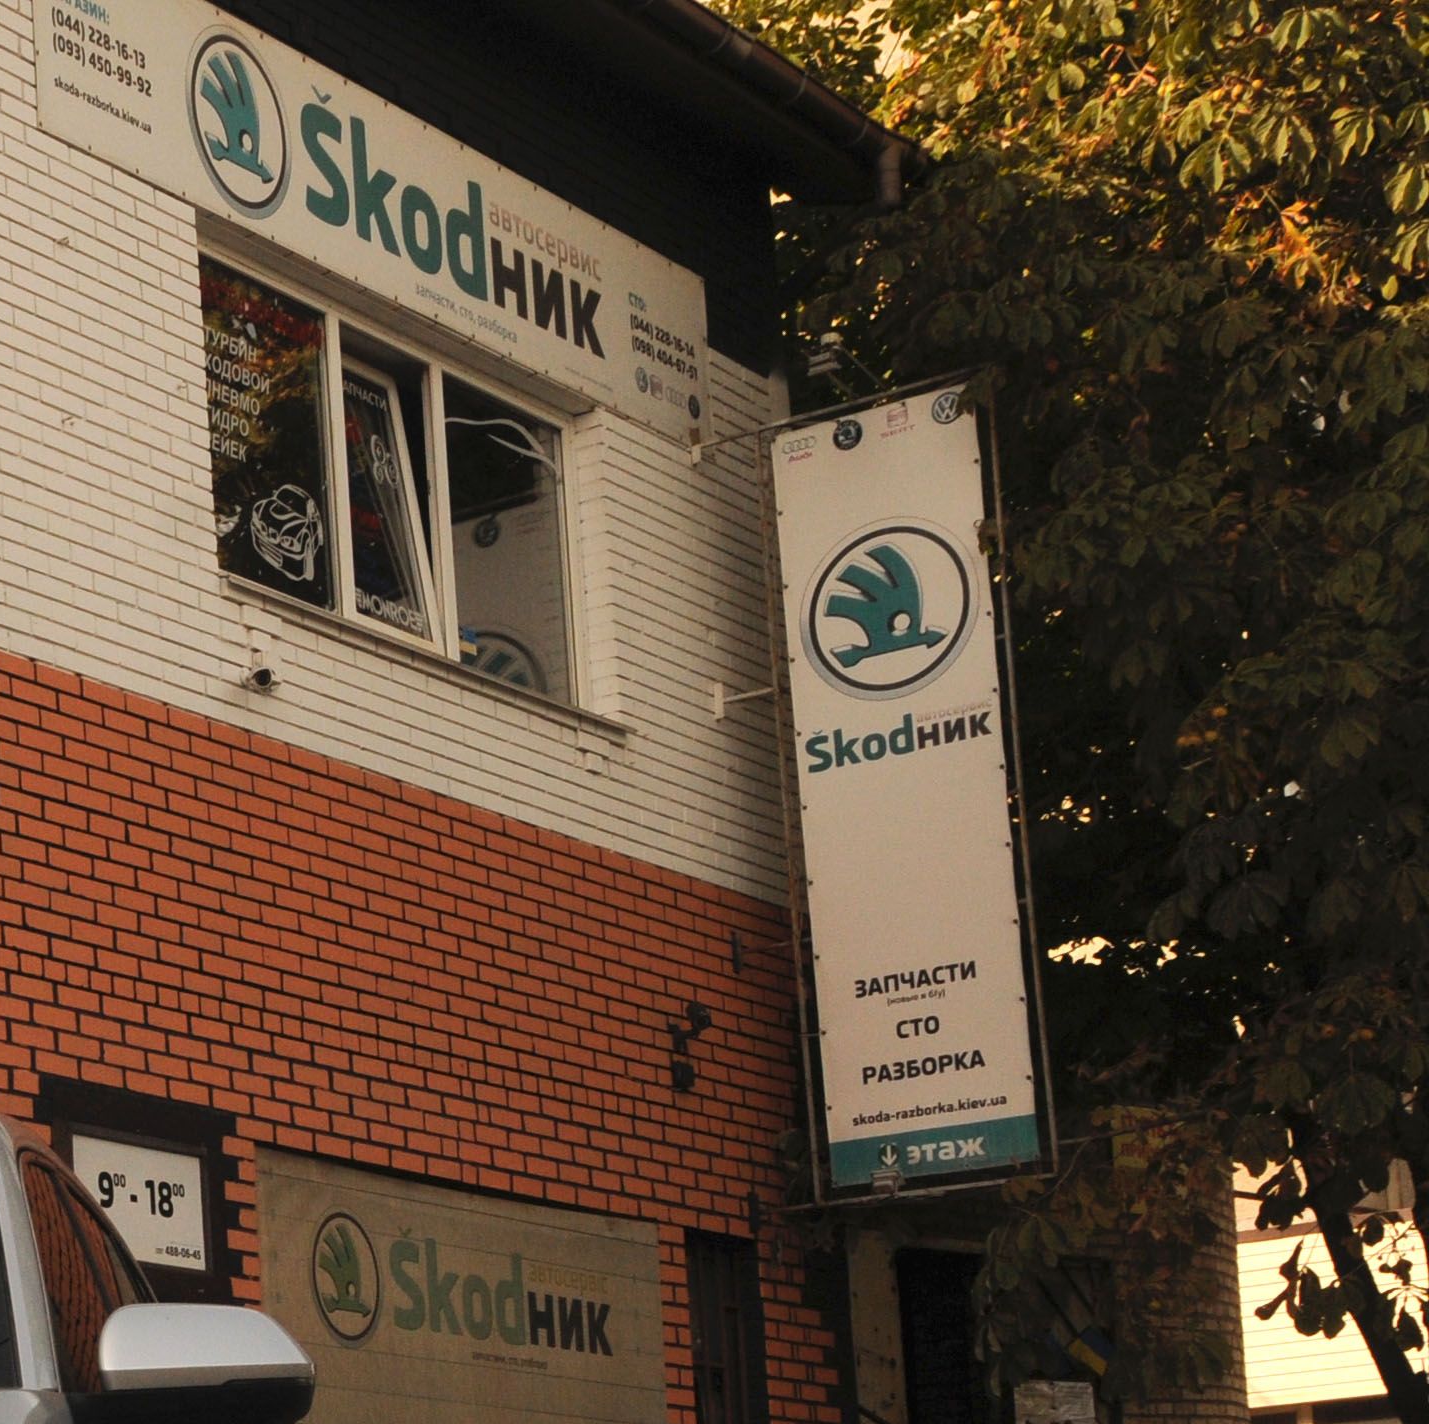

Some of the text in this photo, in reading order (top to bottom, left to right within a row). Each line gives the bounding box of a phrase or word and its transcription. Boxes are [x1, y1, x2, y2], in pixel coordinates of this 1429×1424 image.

[65, 0, 110, 26] АЗИН:
[51, 6, 146, 69] (044) 228-16-13
[52, 33, 152, 97] (093) 450-99-92
[53, 76, 153, 135] skoda-razborka.kiev.ua
[488, 201, 603, 282] автосервис
[358, 590, 423, 633] MONROE
[853, 960, 977, 999] ЗАПЧАСТИ
[896, 1015, 940, 1039] СТО
[861, 1049, 986, 1086] РАЗБОРКА
[852, 1094, 1008, 1127] skoda-razborka.kiev.ua
